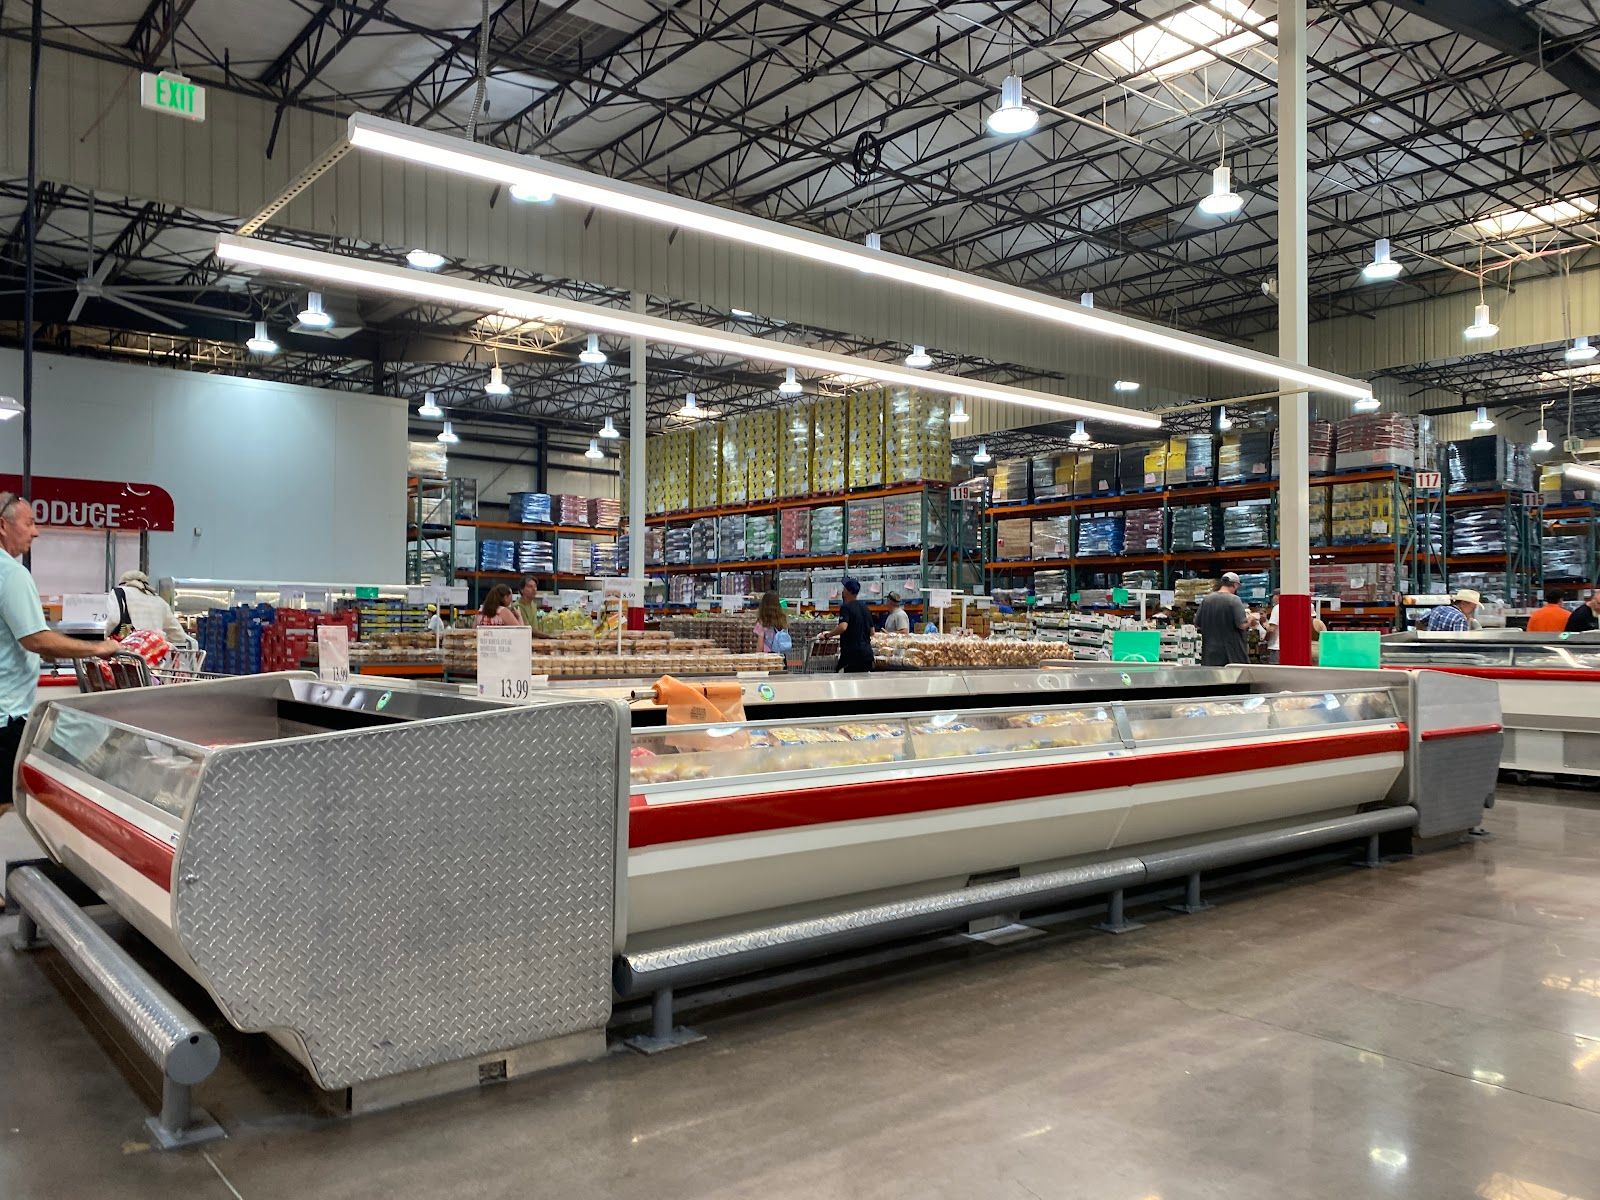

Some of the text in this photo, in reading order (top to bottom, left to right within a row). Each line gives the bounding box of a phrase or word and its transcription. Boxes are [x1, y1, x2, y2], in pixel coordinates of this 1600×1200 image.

[156, 76, 196, 112] EXIT
[1418, 474, 1439, 486] 117
[953, 487, 969, 499] 119
[1525, 494, 1545, 505] 115
[31, 499, 120, 528] ODUCE
[92, 613, 108, 622] 7.9
[501, 679, 529, 699] 13.99
